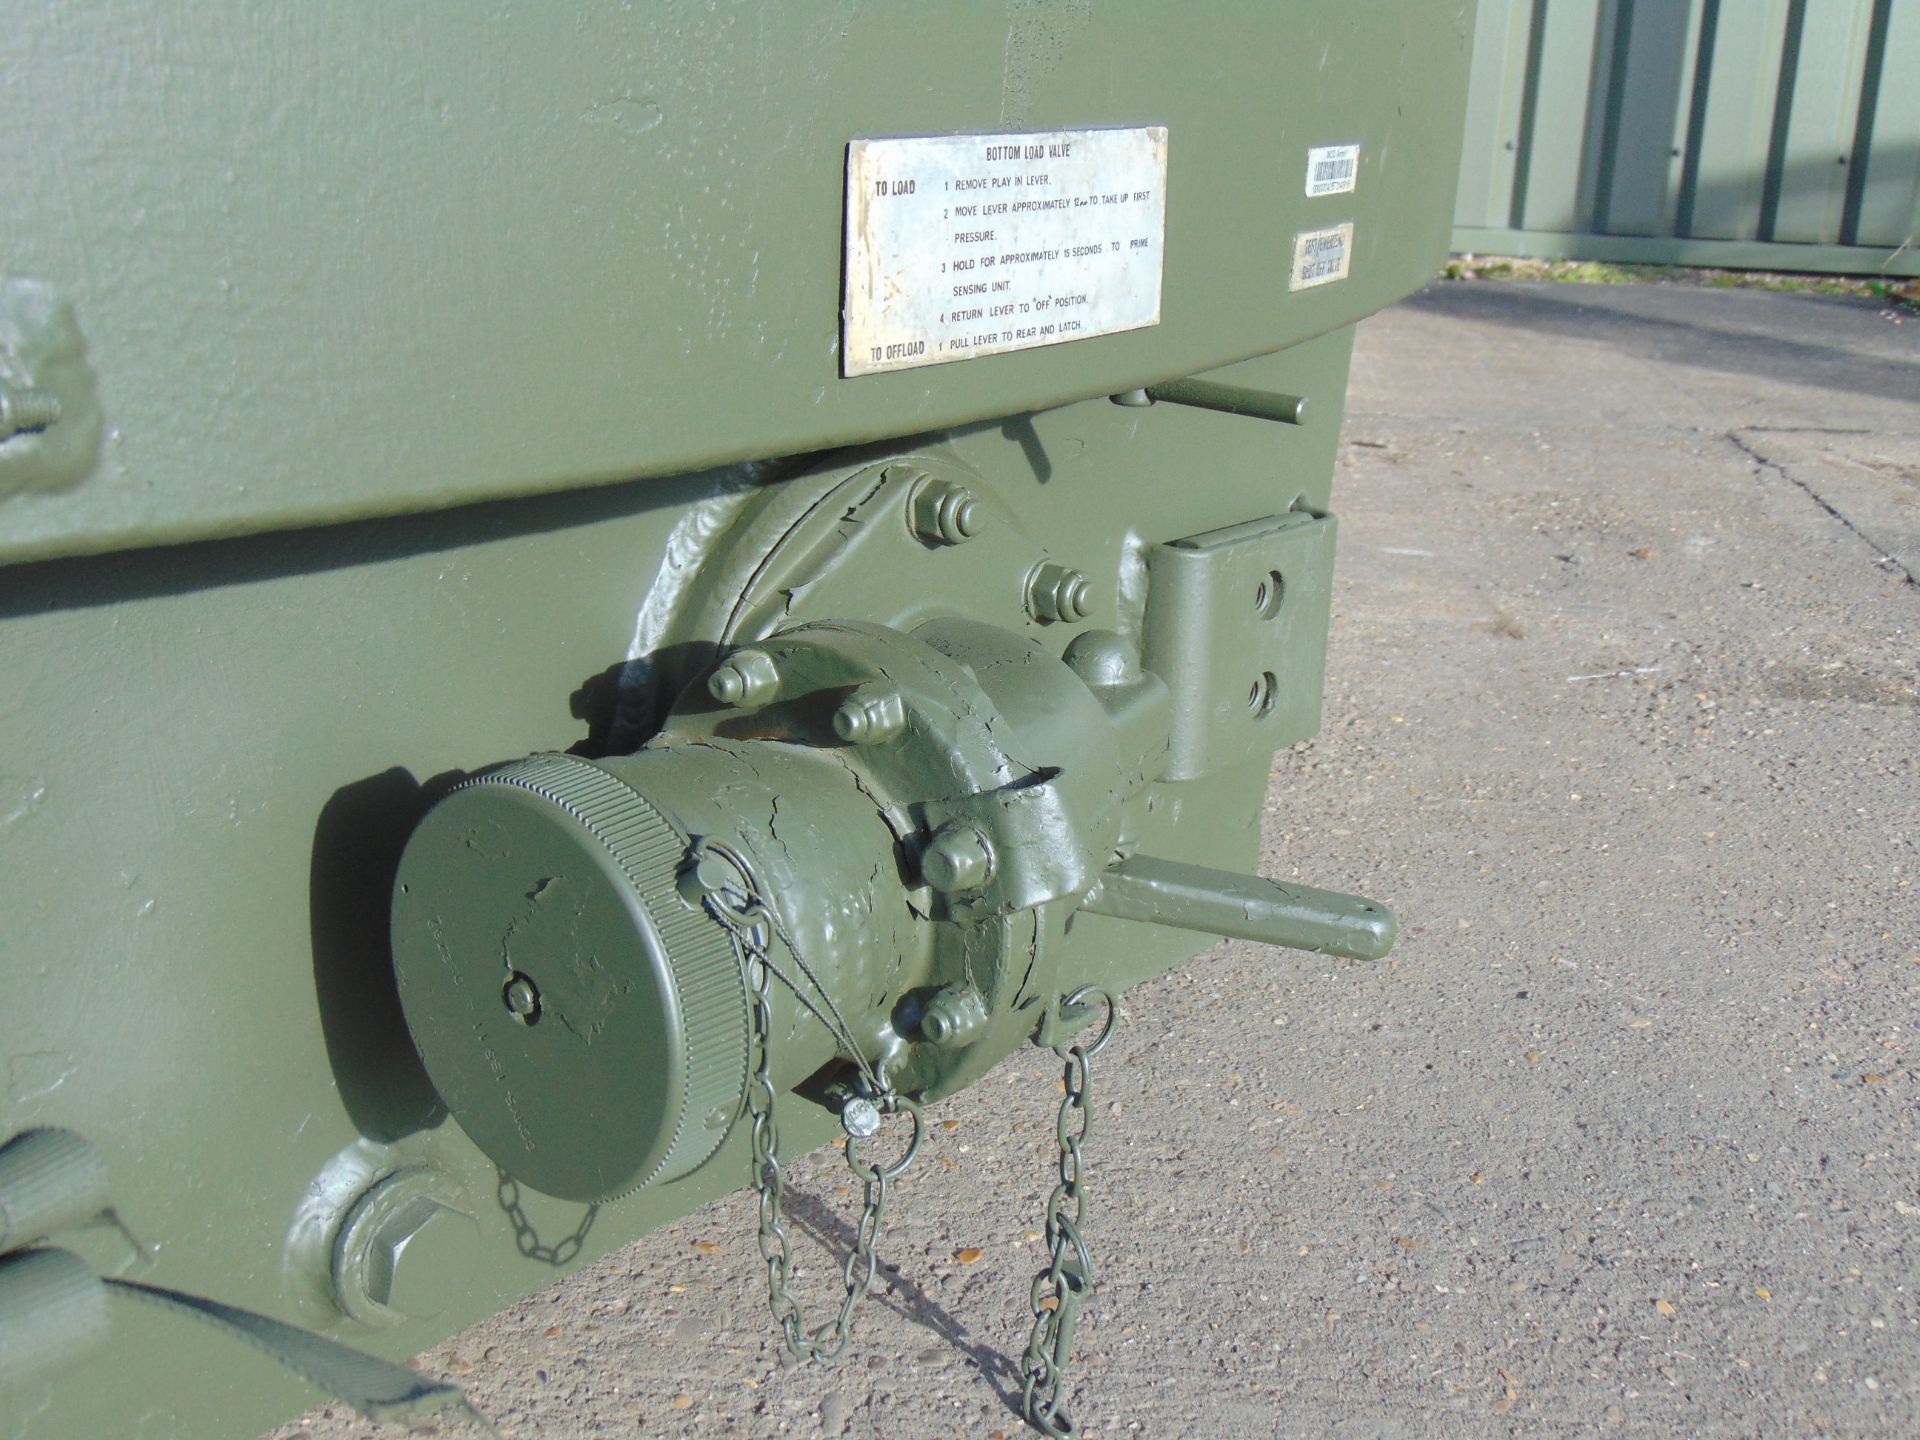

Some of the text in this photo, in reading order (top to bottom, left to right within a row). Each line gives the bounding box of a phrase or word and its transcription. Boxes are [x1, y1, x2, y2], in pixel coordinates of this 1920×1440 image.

[986, 143, 1071, 161] BOTTOM LOAD VALVE
[875, 180, 916, 196] TO LOAD
[944, 174, 1052, 191] 1 REMOVE PLAY IN LEVER.
[943, 209, 949, 219] 2
[955, 206, 978, 217] MOVE
[982, 203, 1008, 216] LEVER
[1012, 199, 1071, 213] APPROXIMATELY
[1089, 196, 1099, 205] TO
[1102, 194, 1118, 204] TAKE
[1120, 193, 1129, 203] UP
[1133, 191, 1150, 202] FIRST
[954, 230, 997, 243] PRESSURE.
[941, 238, 1149, 273] 3 HOLD FOR APPROXIMATELY 15 SECONDS TO PRIME
[953, 281, 1011, 297] SENSING UNIT.
[939, 312, 944, 323] 4
[951, 308, 983, 323] RETURN
[989, 304, 1015, 317] LEVER
[1019, 303, 1030, 313] TO
[1055, 294, 1089, 308] POSITION.
[939, 320, 1081, 352] 1 PULL LEVER TO REAR AND LATCH
[870, 340, 925, 362] TO OFFLOAD
